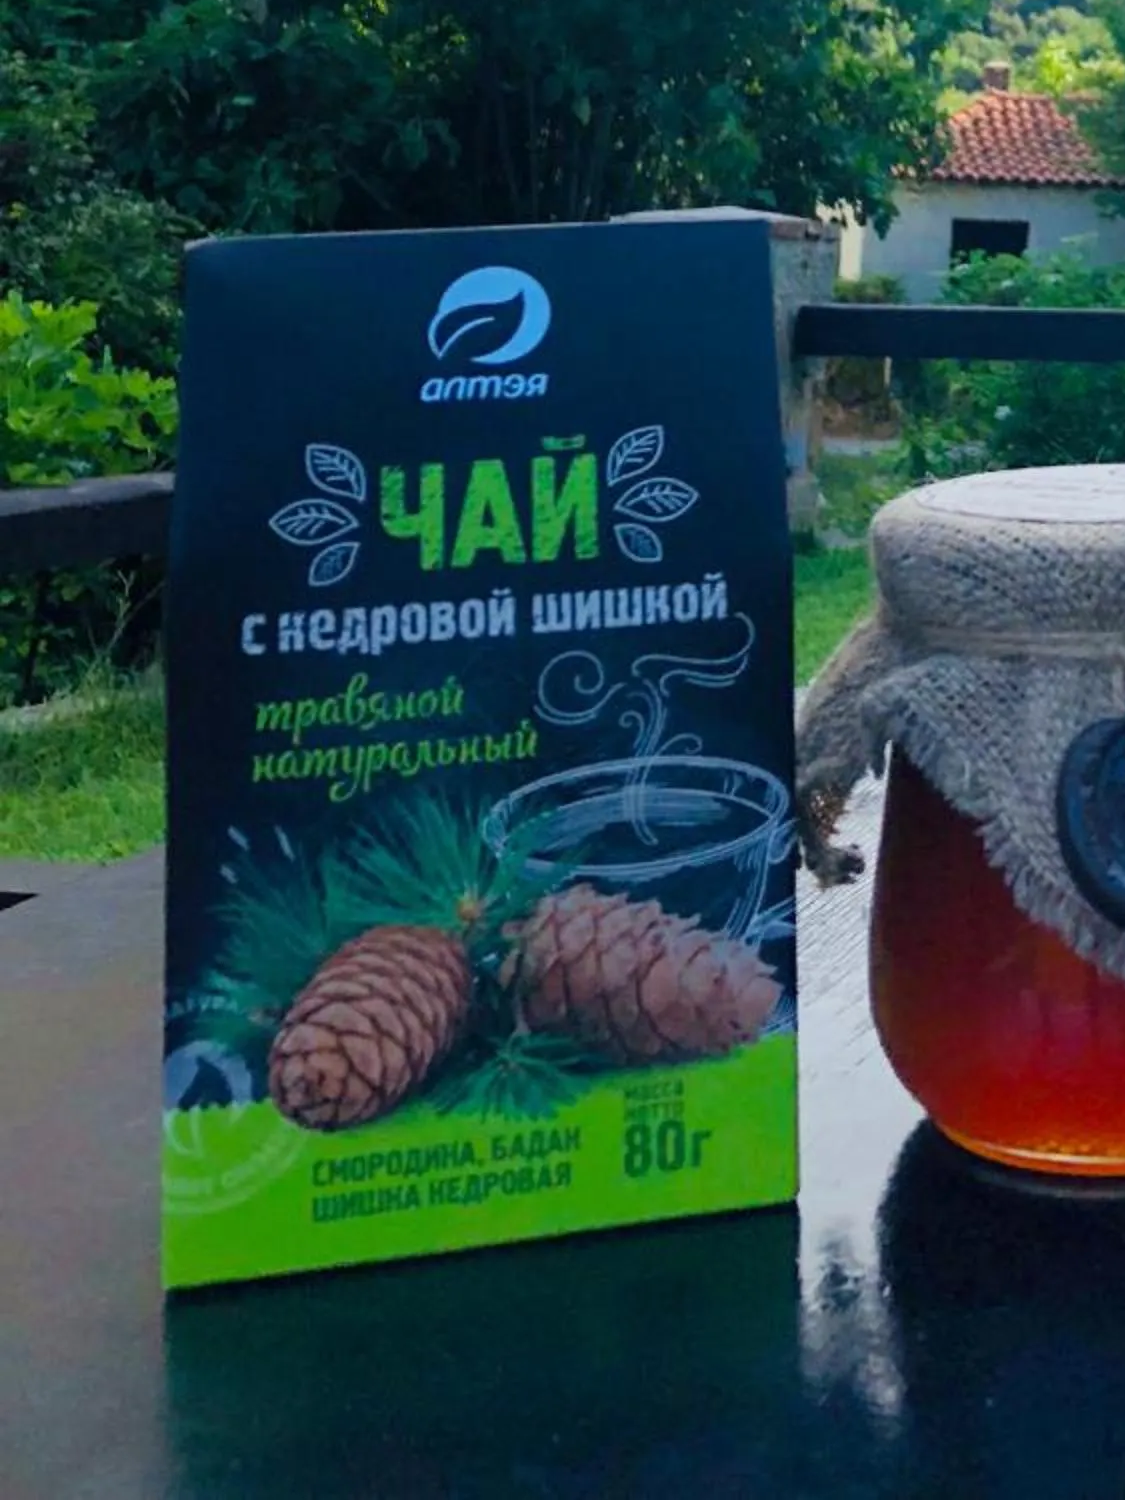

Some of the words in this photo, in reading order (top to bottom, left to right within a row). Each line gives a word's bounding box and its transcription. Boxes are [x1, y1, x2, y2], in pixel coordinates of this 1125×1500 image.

[378, 434, 600, 572] ЧАЙ
[254, 671, 465, 745] травяной
[251, 718, 538, 802] натуральный
[490, 1126, 581, 1161] БАДАН
[624, 1119, 713, 1178] 80г
